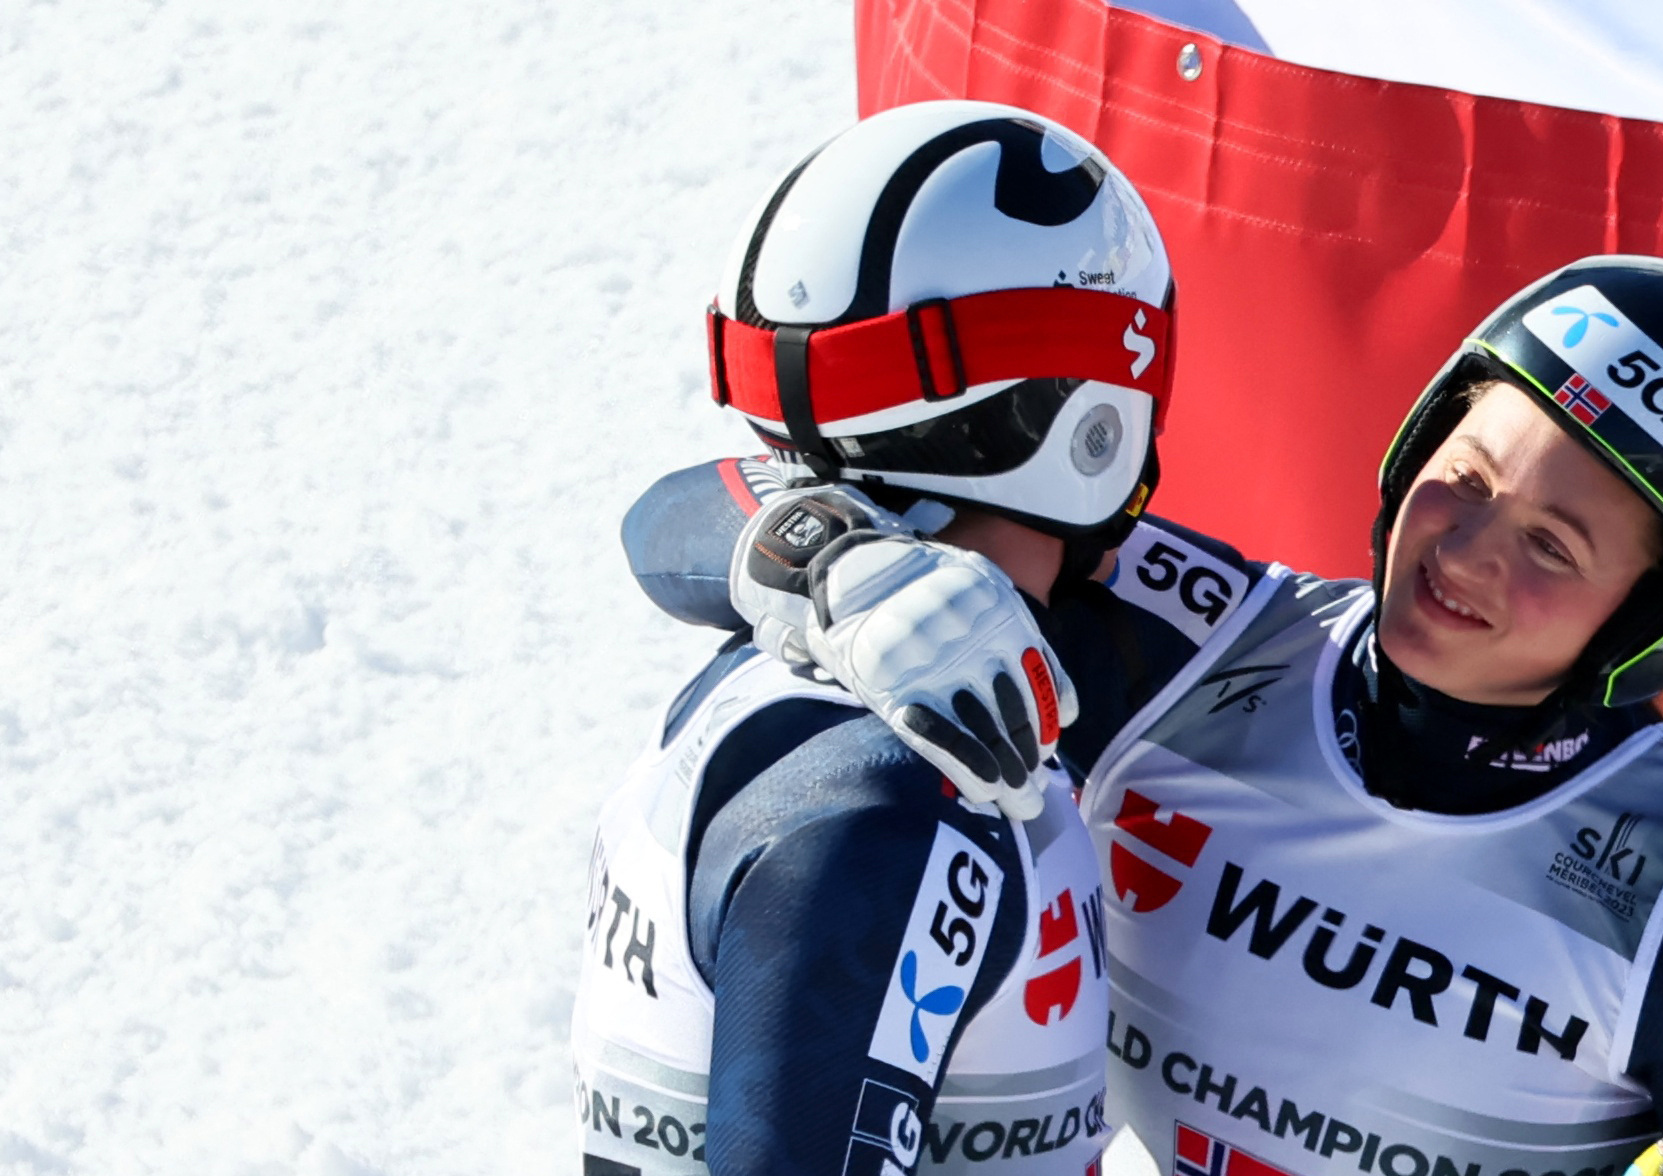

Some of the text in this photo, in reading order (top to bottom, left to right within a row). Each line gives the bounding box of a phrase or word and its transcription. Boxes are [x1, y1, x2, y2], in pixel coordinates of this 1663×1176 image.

[1079, 269, 1116, 286] Sweet
[1136, 541, 1233, 627] 5G
[1570, 811, 1646, 887] SKI
[930, 851, 989, 967] 5G
[1205, 862, 1590, 1062] WÜRTH
[926, 1106, 1081, 1165] WORLD
